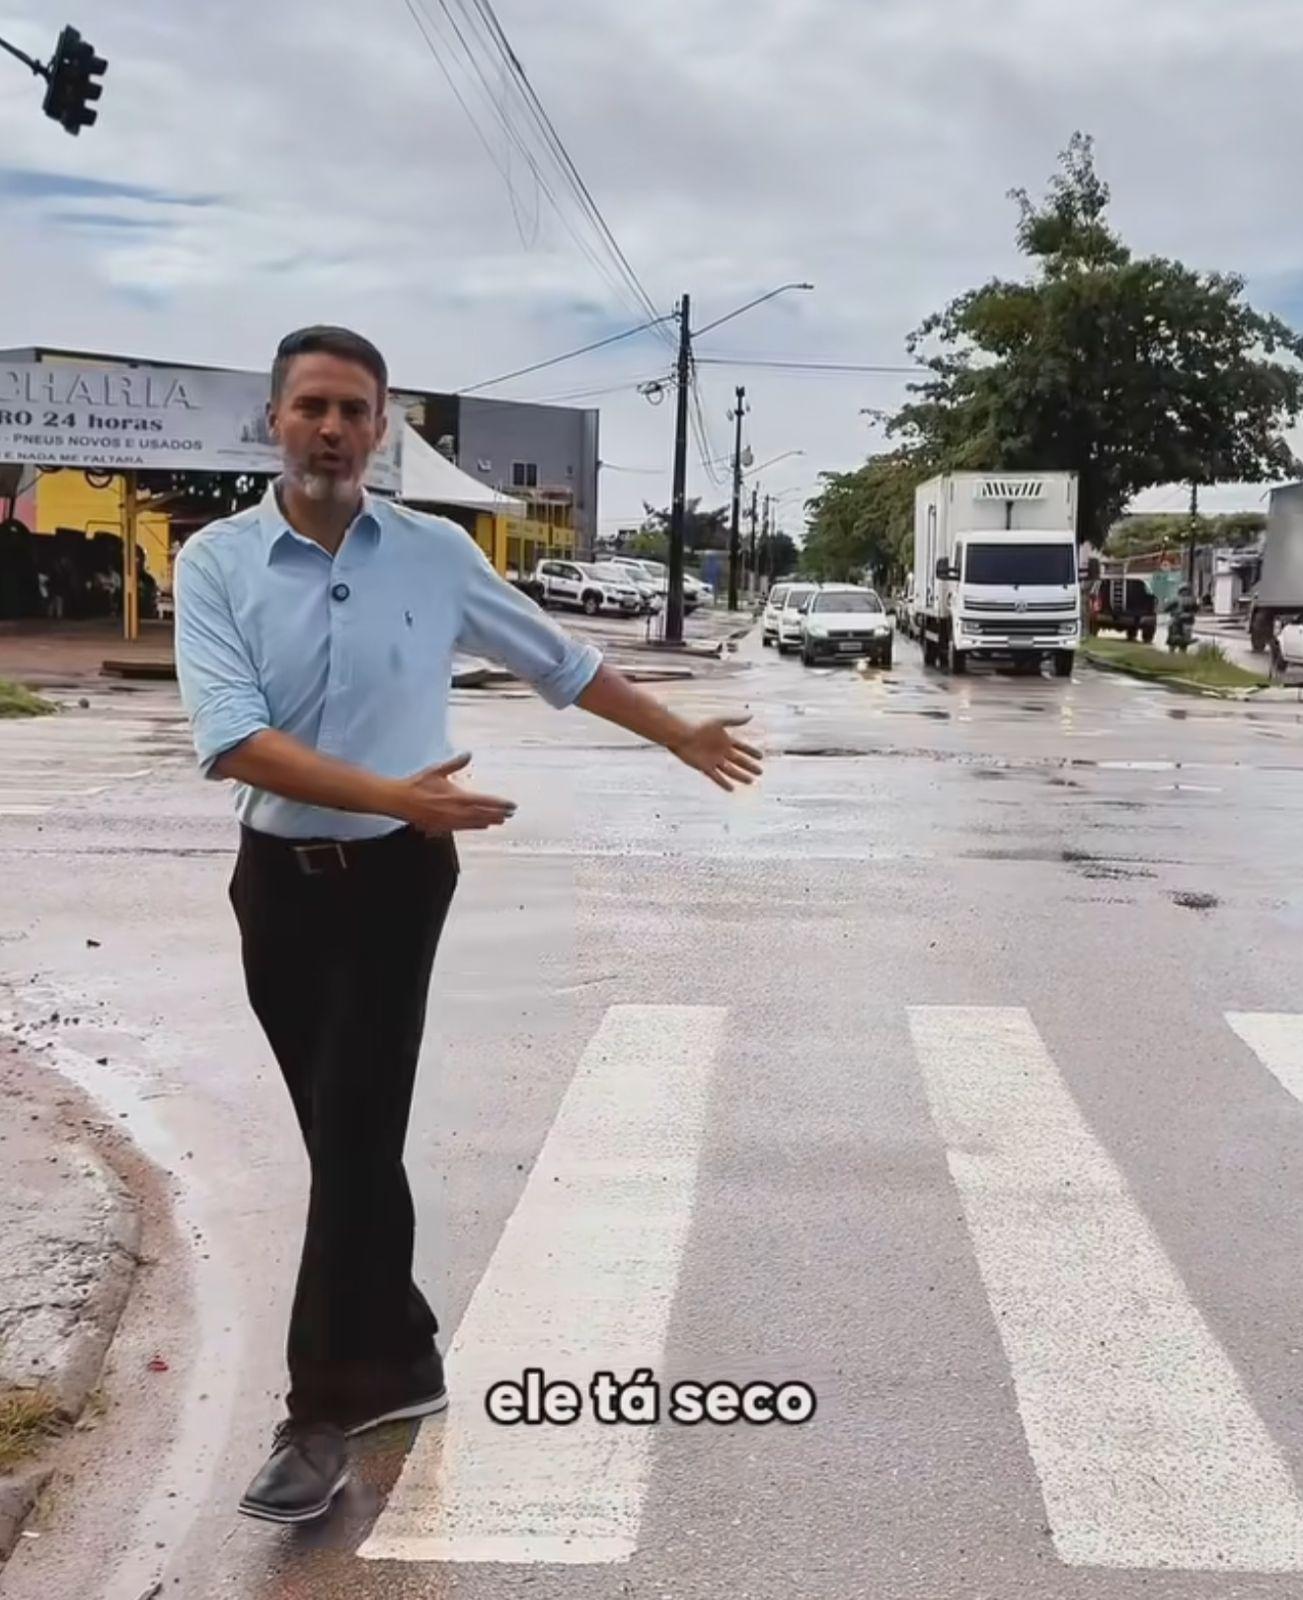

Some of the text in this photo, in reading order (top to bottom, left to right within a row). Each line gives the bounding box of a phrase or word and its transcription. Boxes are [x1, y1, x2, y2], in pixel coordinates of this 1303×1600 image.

[43, 412, 76, 428] 24
[88, 414, 163, 431] horas
[13, 433, 64, 446] PNEUS
[68, 436, 121, 448] NOVOS
[125, 439, 136, 448] E
[139, 439, 202, 450] USADOS
